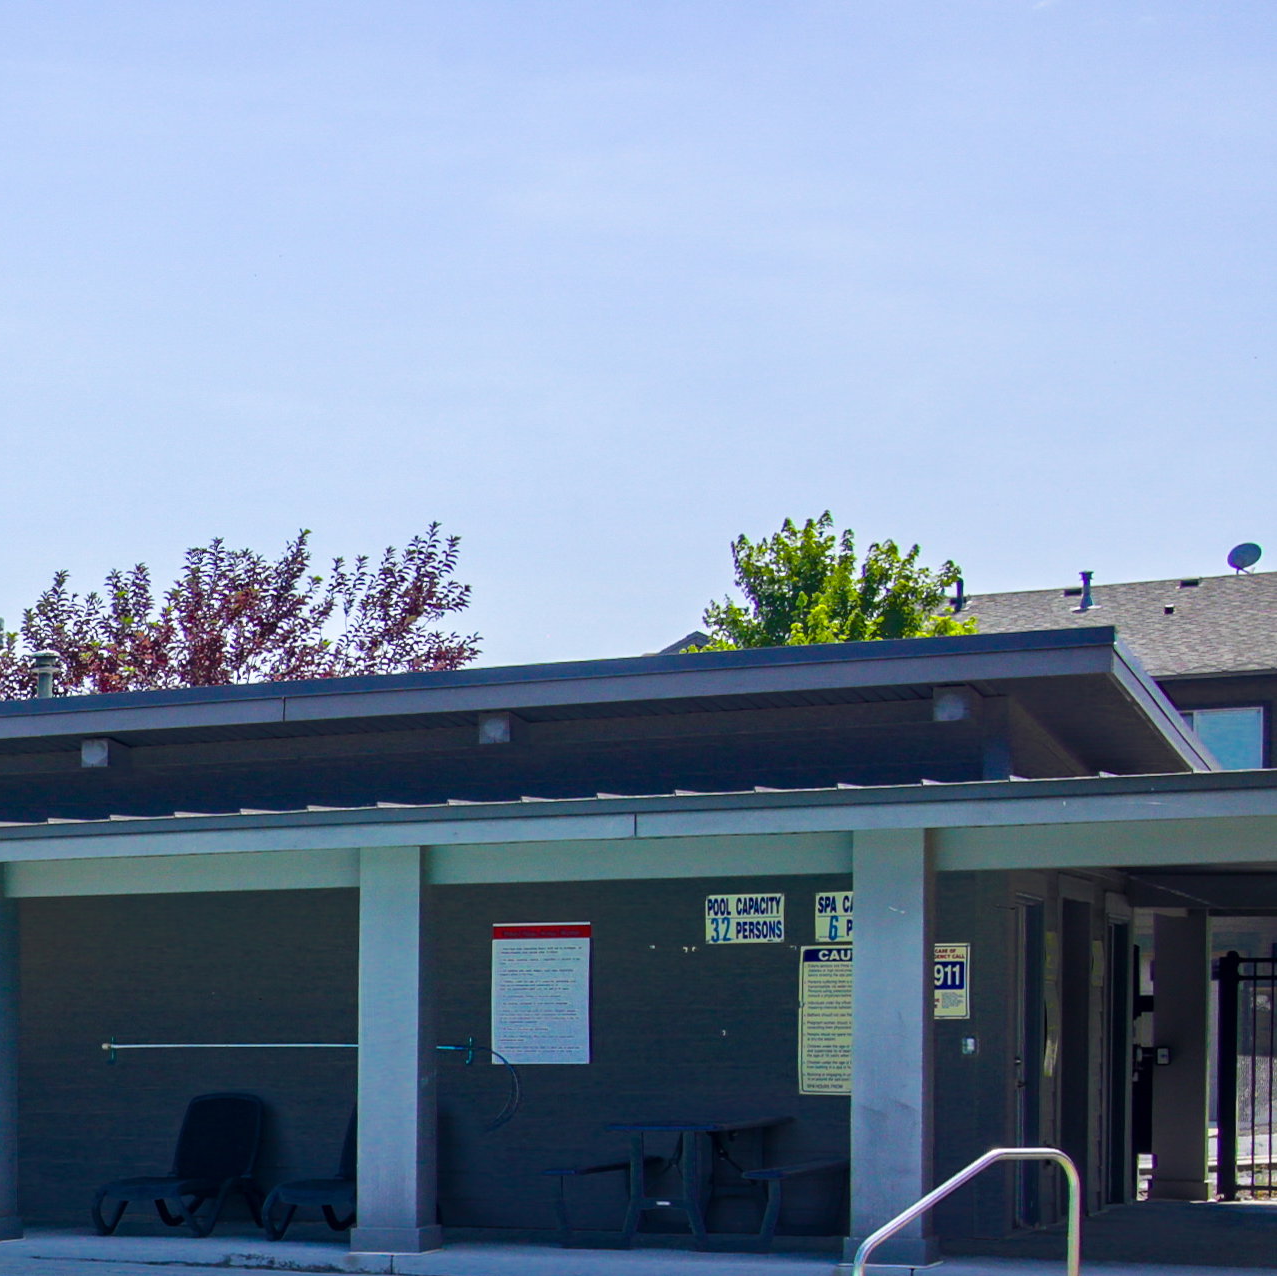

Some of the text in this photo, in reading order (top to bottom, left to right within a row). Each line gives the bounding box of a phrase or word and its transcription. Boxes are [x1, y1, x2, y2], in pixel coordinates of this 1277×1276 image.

[707, 896, 781, 916] POOL CAPACITY
[817, 895, 837, 914] SPA
[711, 916, 782, 942] 32 PERSONS
[828, 915, 839, 941] 6
[934, 964, 960, 986] 911
